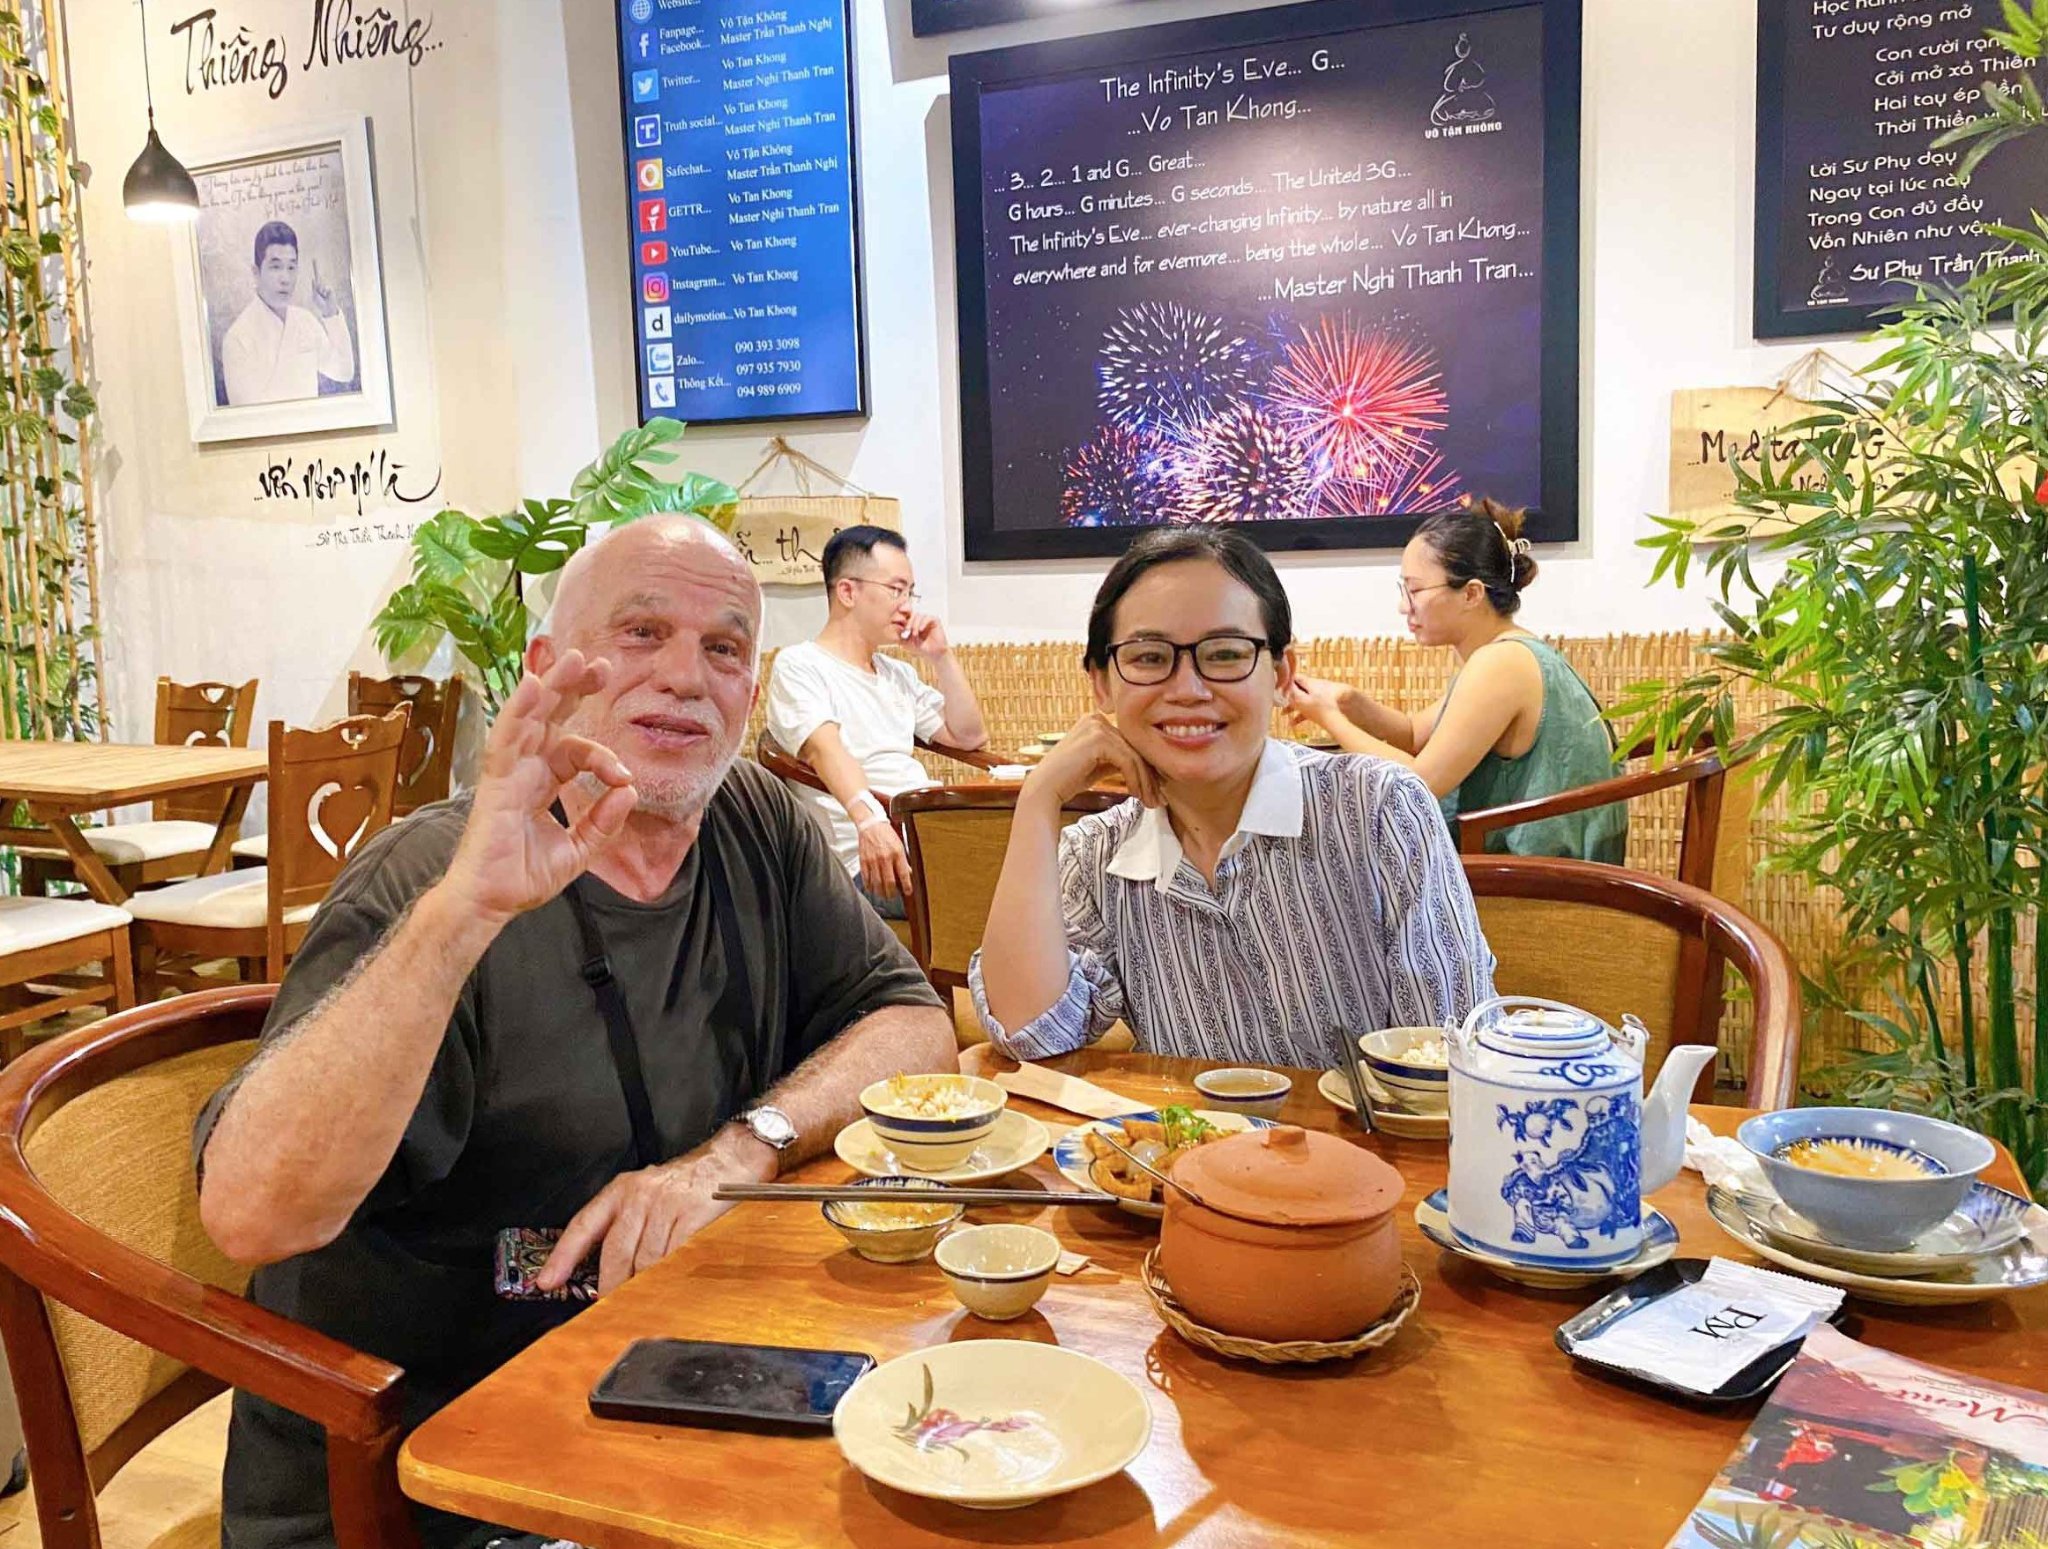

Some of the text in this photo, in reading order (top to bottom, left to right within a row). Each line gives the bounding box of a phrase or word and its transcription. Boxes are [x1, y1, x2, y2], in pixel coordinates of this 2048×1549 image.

[1813, 0, 1850, 16] Học
[720, 22, 806, 45] Master Thanh
[1813, 6, 1973, 40] Tư duy rộng mở
[722, 52, 787, 70] Vo Tan Khong
[1875, 38, 1959, 63] Con cười
[723, 65, 834, 91] Master Nghi Thanh Tran
[1100, 49, 1345, 103] The Infinity's Eve... G...
[1874, 68, 1904, 87] Cởi
[1911, 65, 1943, 83] mở
[1948, 59, 1974, 78] xả
[724, 98, 788, 115] Vo Tan Khong
[1874, 86, 1981, 112] Hai tay ép
[725, 111, 836, 136] Master Nghi Thanh Tran
[1180, 104, 1218, 130] Tan
[1226, 94, 1311, 123] Khong...
[1875, 118, 1916, 137] Thời
[1923, 109, 1978, 131] Thiền
[664, 118, 688, 132] Truth
[727, 168, 758, 181] Master
[783, 159, 812, 174] Thanh
[1072, 165, 1082, 184] 1
[1087, 160, 1111, 182] and
[1116, 159, 1142, 177] G...
[1149, 150, 1205, 172] Great...
[1810, 151, 1957, 178] Lời Sư Phụ dạy
[728, 188, 793, 204] Vo Tan Khong
[1008, 160, 1411, 221] G hours... G minutes... G seconds... The United 3G...
[1809, 172, 1971, 204] Ngay tại lúc này
[729, 202, 840, 225] Master Nghi Thanh Tran
[1009, 188, 1453, 255] The Infinity's Eve... ever-changing Infinity... by nature all in
[1808, 194, 1983, 227] Trong Con đủ đầy
[731, 235, 797, 251] Vo Tan Khong
[1808, 224, 1953, 251] Vốn Nhiên như
[1013, 216, 1530, 286] everywhere and for evermore... being the whole... Vo Tan Khong...
[732, 269, 798, 284] Vo Tan Khong
[1353, 263, 1394, 295] Nghi
[1401, 259, 1462, 290] Thanh
[1468, 257, 1534, 284] Tran...
[1850, 263, 1879, 281] Sư
[1885, 259, 1922, 279] Phụ
[1929, 254, 1974, 276] Trần
[733, 304, 797, 319] Vo Tan Khong
[735, 337, 800, 354] 090 393 3098
[736, 360, 801, 376] 097 935 7930
[678, 377, 706, 390] Thông
[737, 382, 801, 398] 094 989 6909
